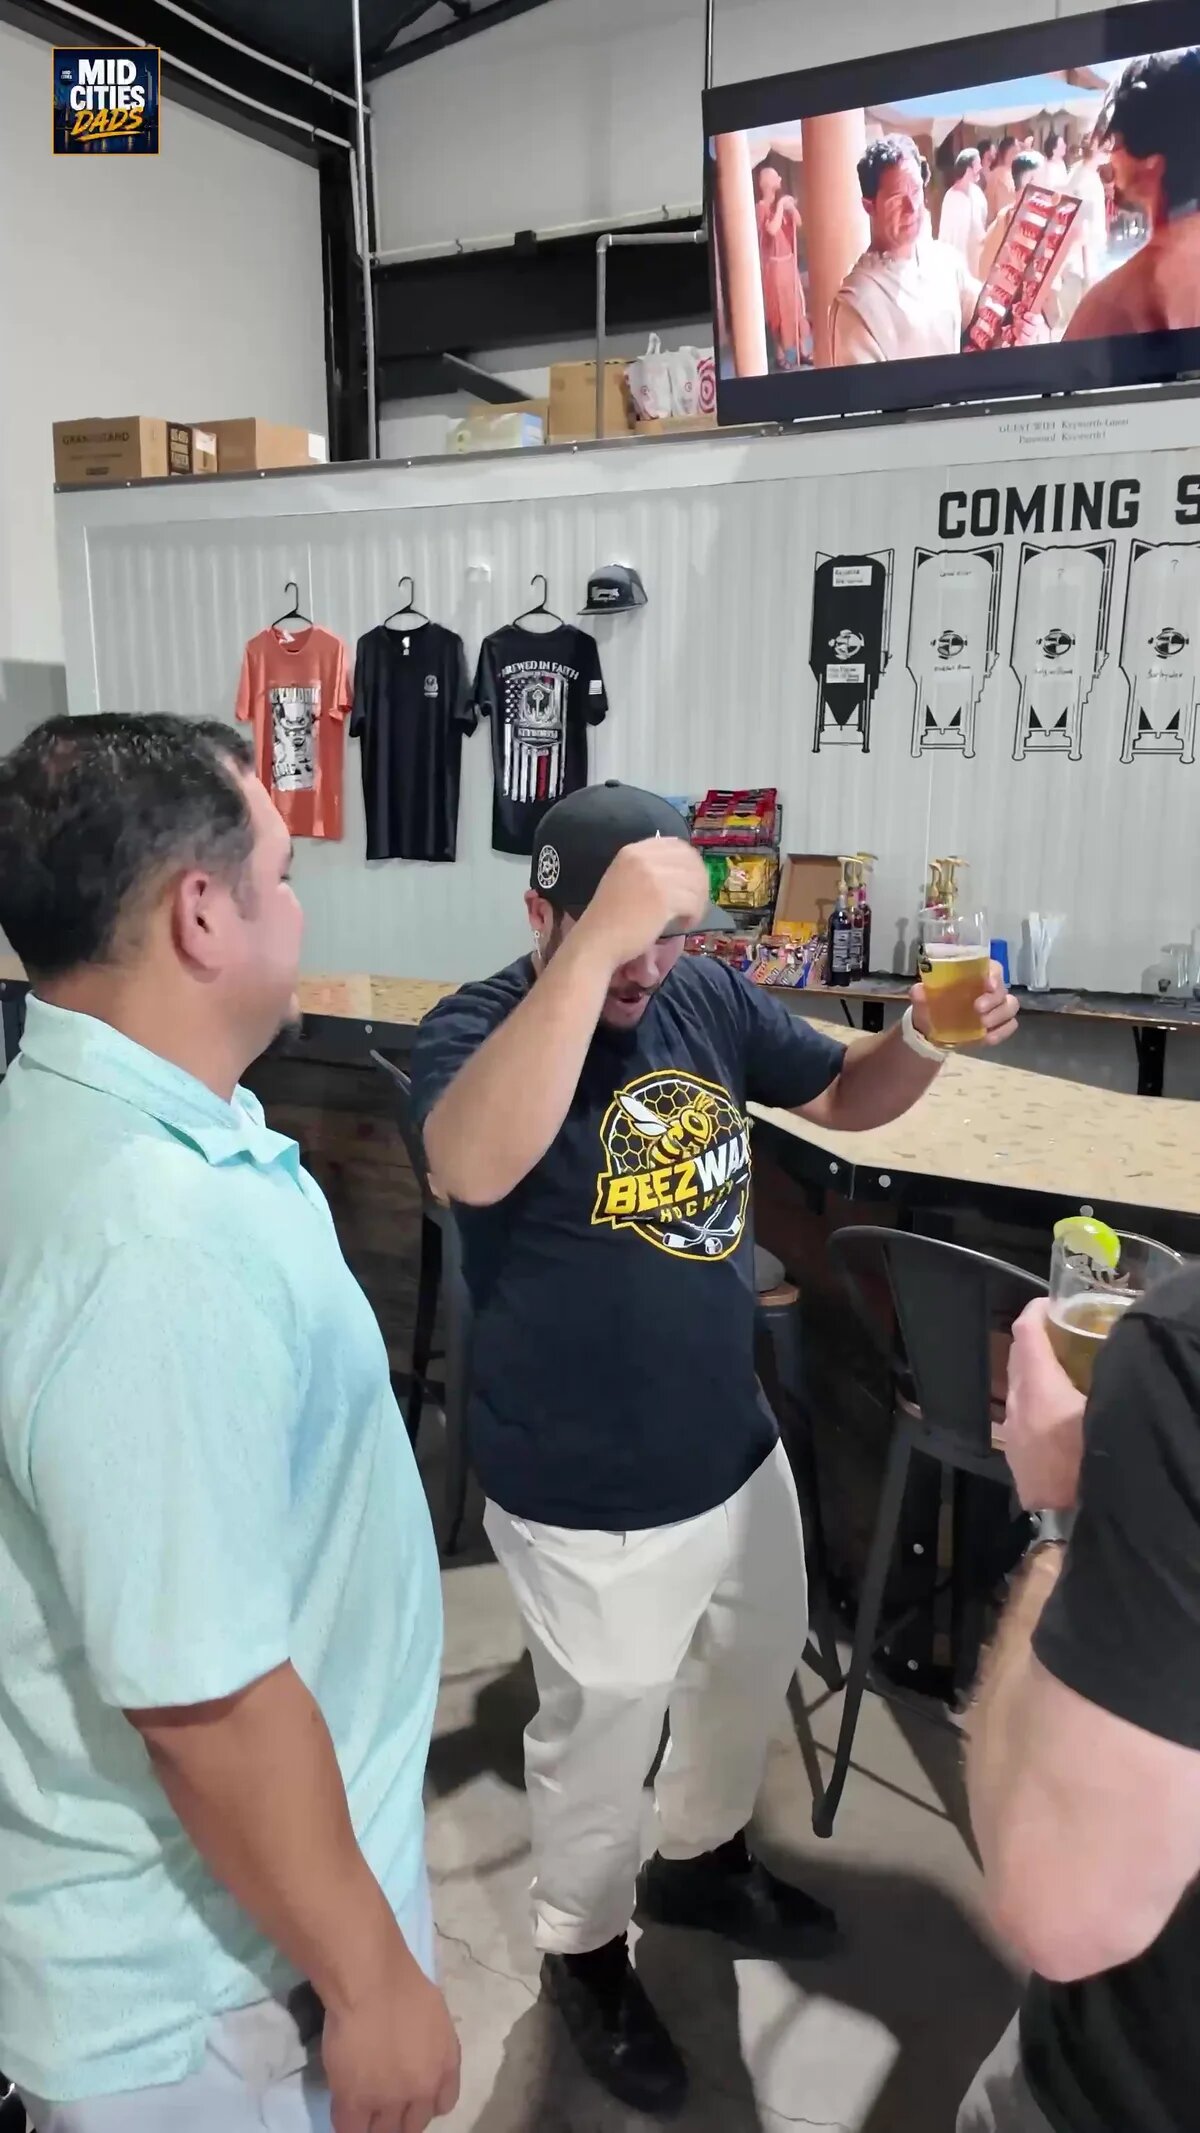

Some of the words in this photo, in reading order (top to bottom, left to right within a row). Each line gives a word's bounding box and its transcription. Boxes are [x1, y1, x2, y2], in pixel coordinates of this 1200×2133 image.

[938, 478, 1141, 539] COMING
[539, 660, 551, 670] IN
[551, 662, 580, 680] FAITH
[659, 1179, 733, 1224] HOCKEY
